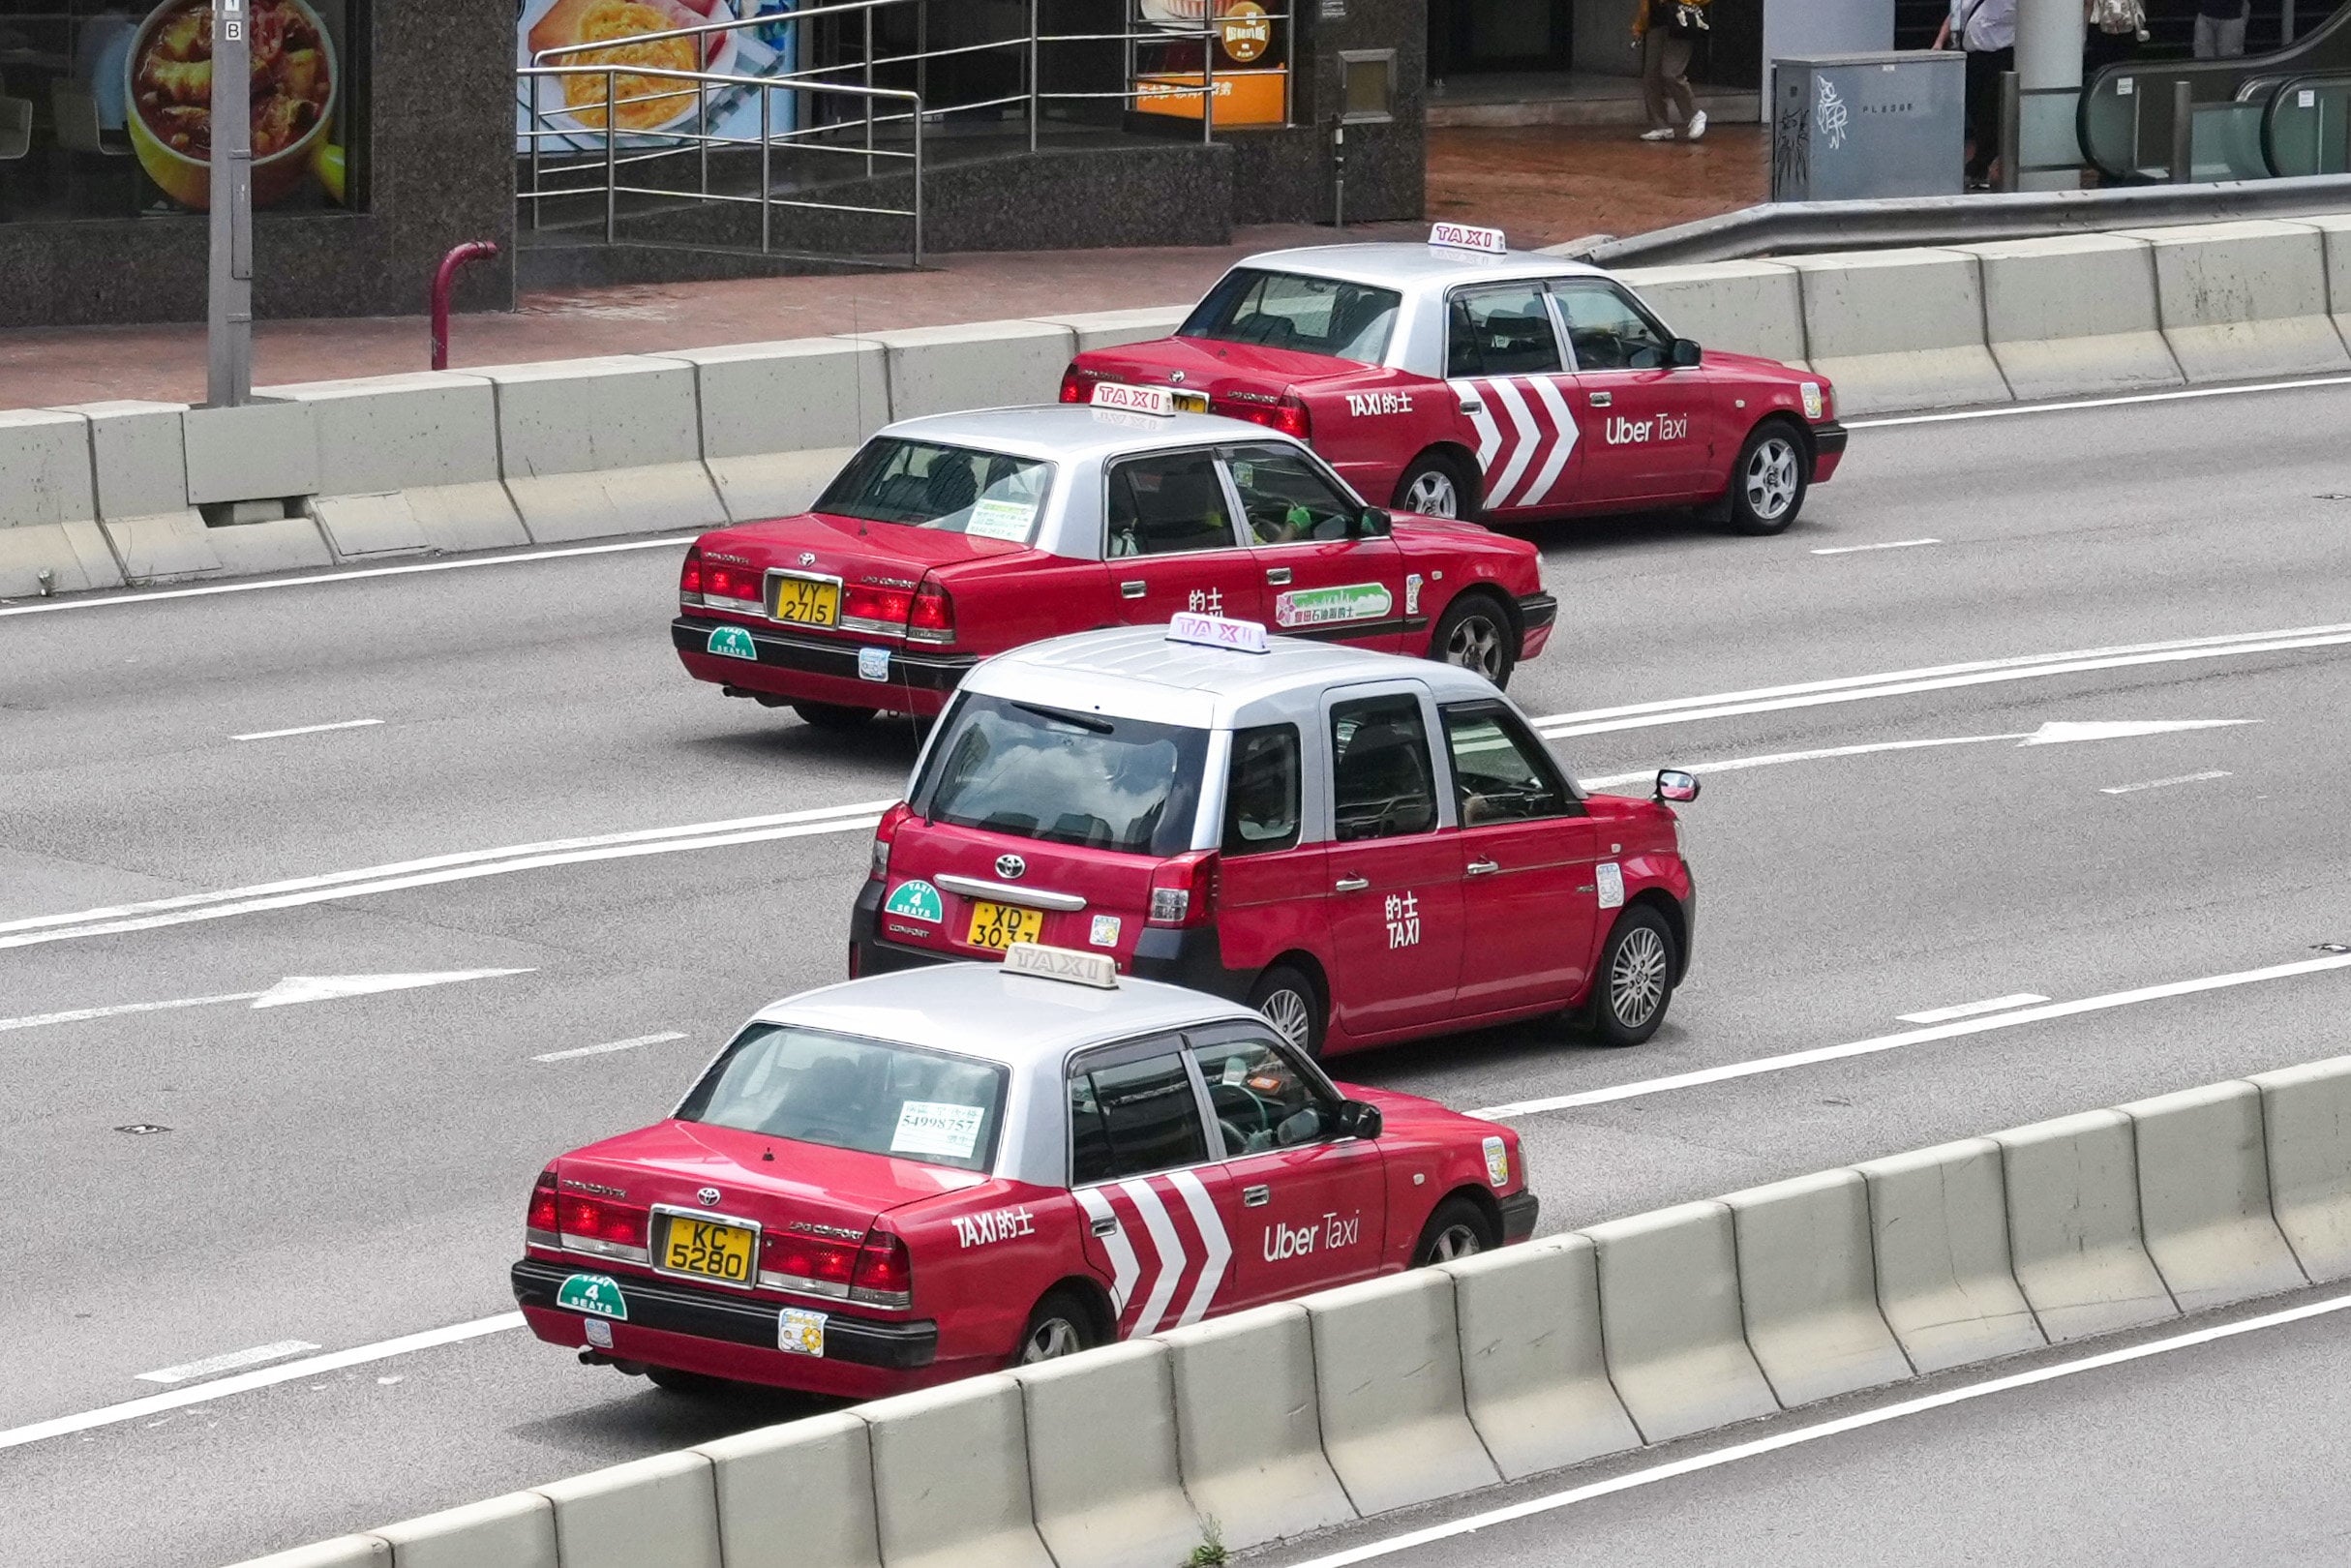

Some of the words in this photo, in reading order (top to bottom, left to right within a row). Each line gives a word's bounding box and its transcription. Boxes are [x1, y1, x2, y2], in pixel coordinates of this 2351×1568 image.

[227, 23, 239, 38] B
[1436, 226, 1492, 248] TAXI
[1099, 385, 1160, 410] TAXI
[1345, 393, 1382, 417] TAXI
[1381, 391, 1413, 414] 的士
[1606, 416, 1653, 445] Uber
[1655, 412, 1687, 440] Taxi
[798, 583, 821, 601] VY
[1189, 587, 1223, 612] 的士
[784, 600, 829, 622] 2715
[726, 634, 736, 648] 4
[1177, 617, 1253, 644] TAXI
[908, 882, 932, 895] TAXI
[910, 891, 922, 908] 4
[896, 903, 931, 919] SEATS
[991, 905, 1023, 929] XD
[1385, 890, 1419, 921] 的士
[1386, 918, 1420, 950] TAXI
[1014, 946, 1100, 980] TAXI
[692, 1222, 729, 1251] KC
[789, 1221, 812, 1232] LPG
[812, 1224, 864, 1240] COMFORT
[951, 1212, 997, 1249] TAXI
[995, 1205, 1036, 1240] 的士
[1263, 1222, 1319, 1262] Uber
[1322, 1209, 1360, 1250] Taxi
[671, 1244, 742, 1278] 5280
[585, 1283, 599, 1301] 4
[571, 1296, 613, 1314] SEATS
